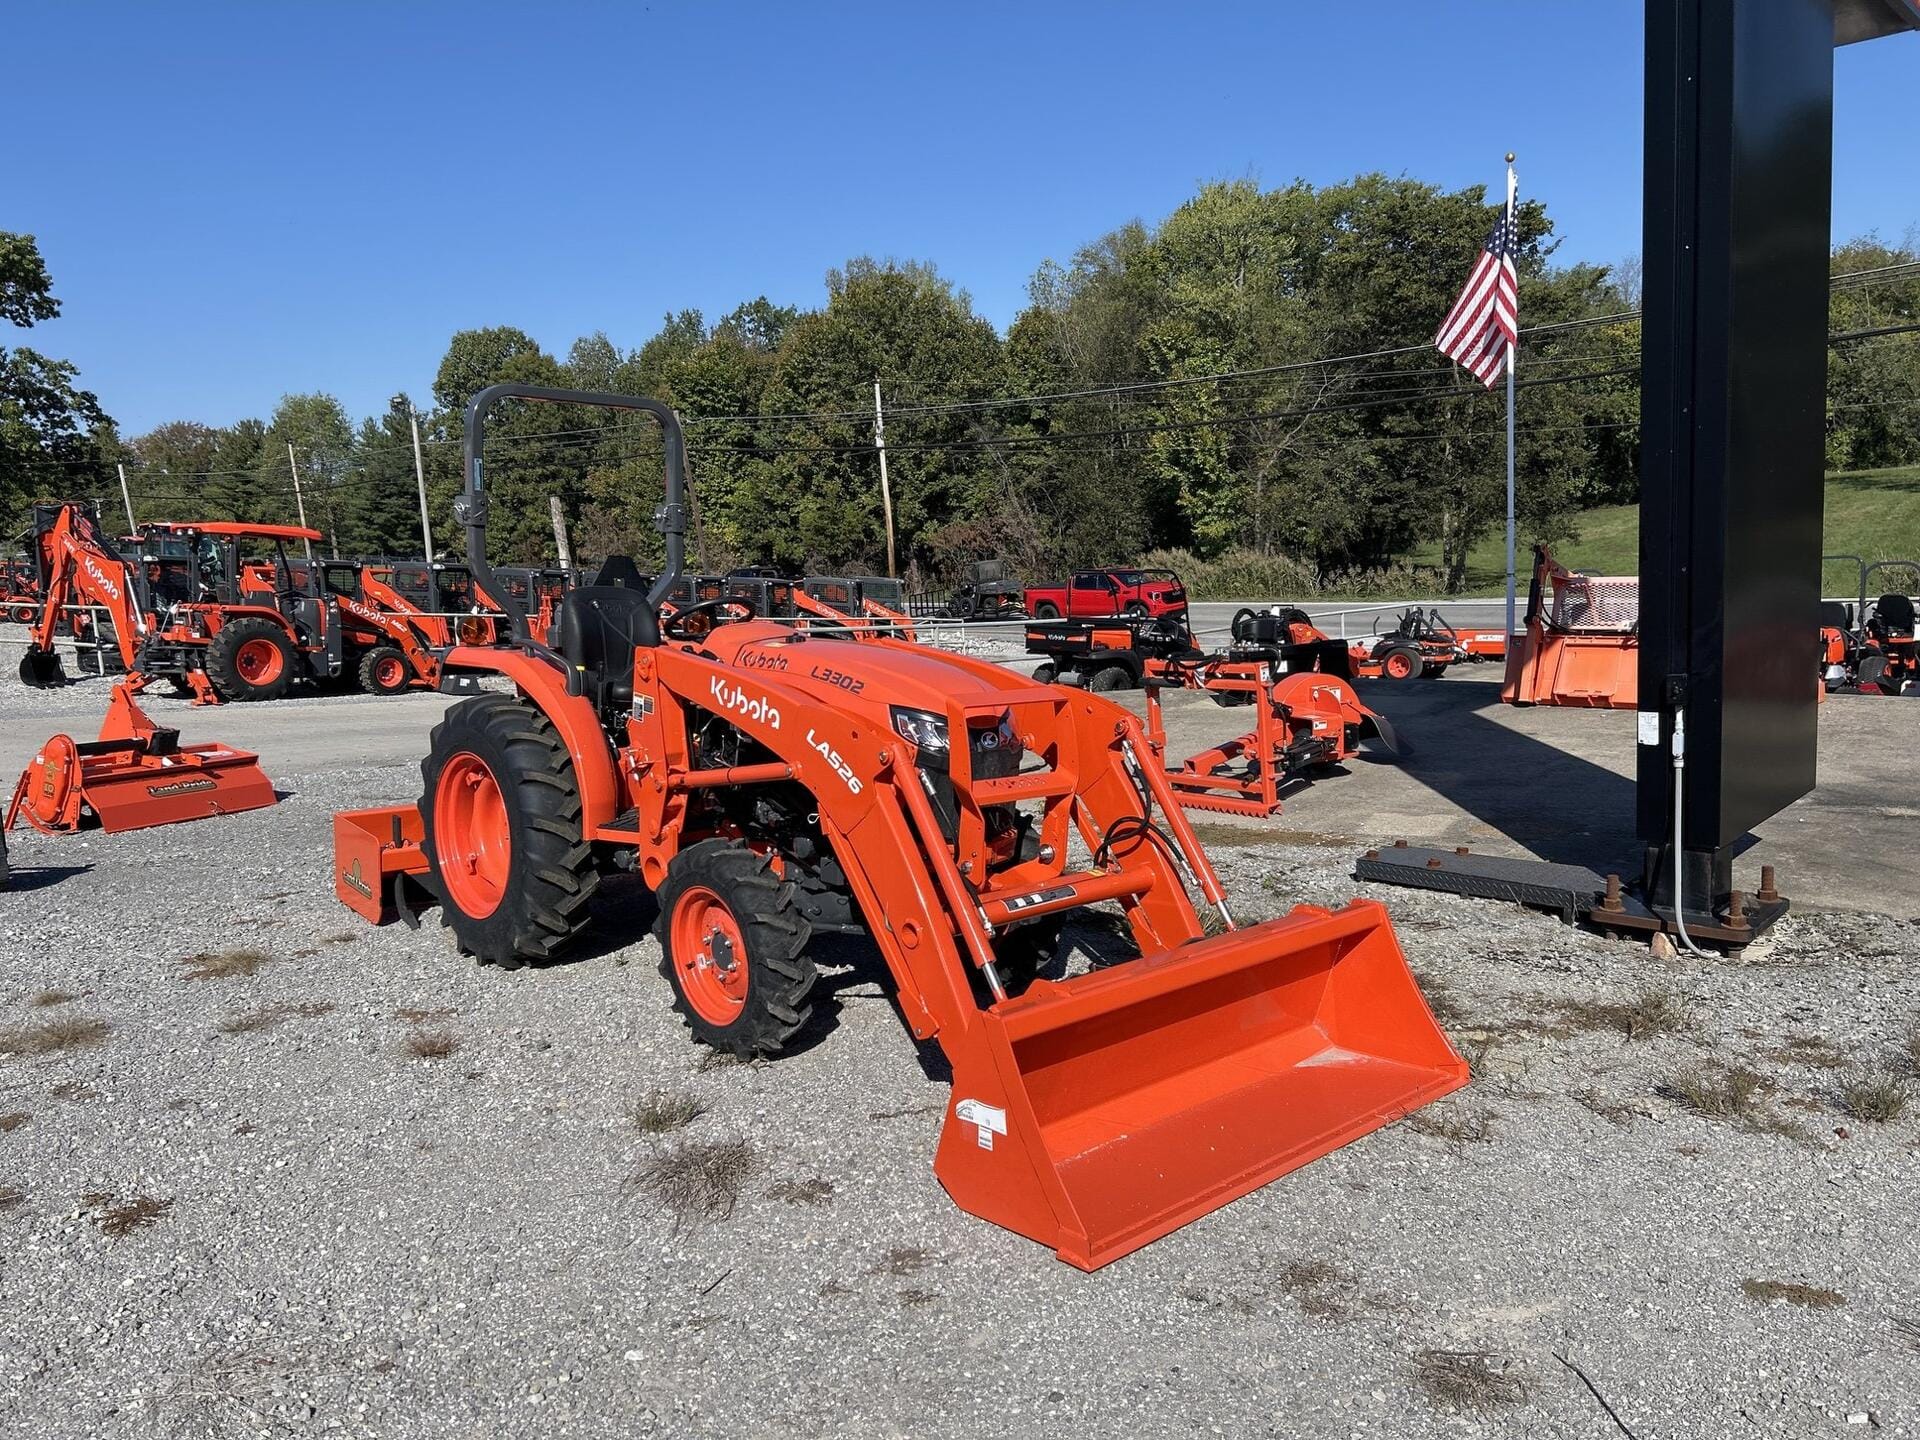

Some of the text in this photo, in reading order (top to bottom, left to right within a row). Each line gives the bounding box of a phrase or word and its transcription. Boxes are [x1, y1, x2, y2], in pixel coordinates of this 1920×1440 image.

[84, 556, 120, 600] Kubota
[349, 600, 386, 624] Kubota
[740, 649, 789, 671] Kubota
[811, 665, 865, 695] L3302
[710, 675, 781, 730] Kubota
[806, 728, 864, 794] LA526
